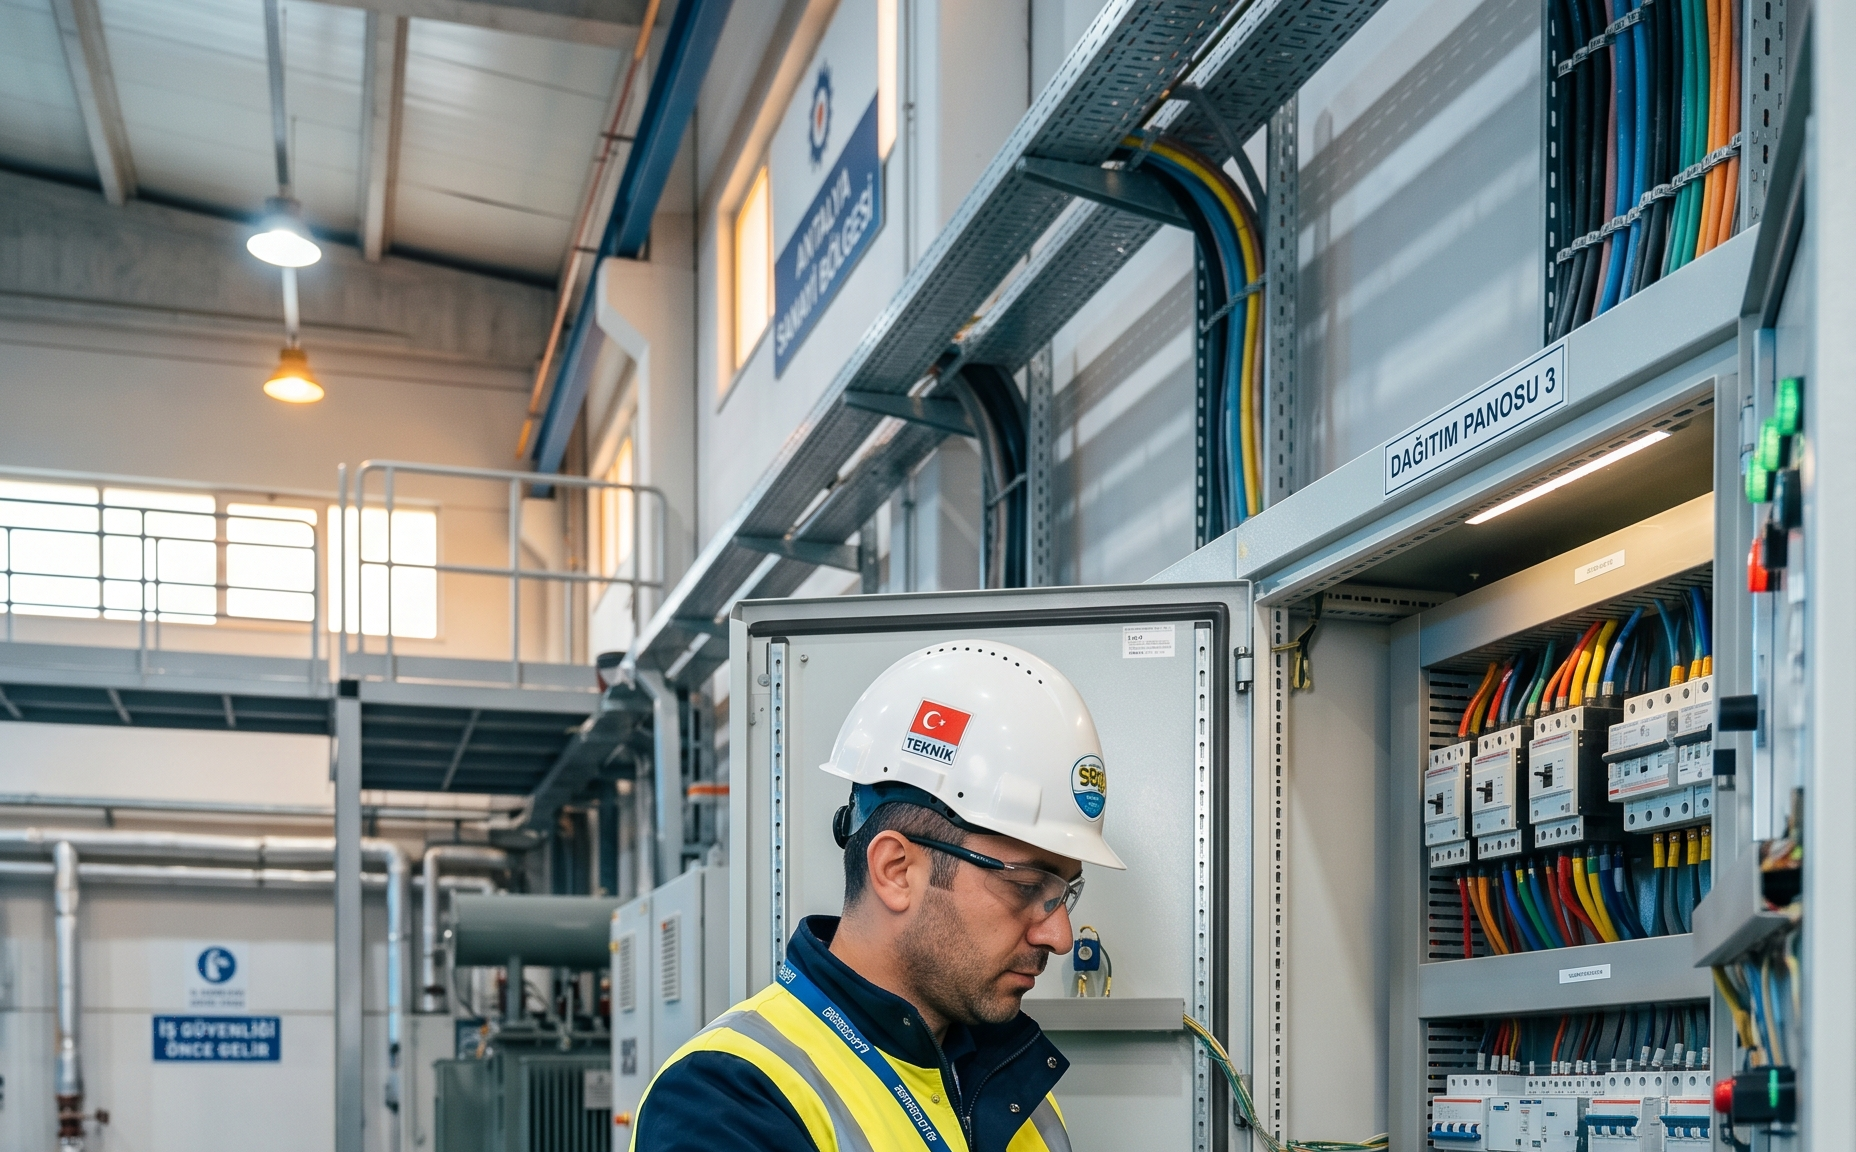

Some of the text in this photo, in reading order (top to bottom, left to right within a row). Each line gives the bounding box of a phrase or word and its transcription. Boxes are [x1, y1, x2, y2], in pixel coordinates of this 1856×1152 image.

[796, 167, 851, 281] ANTALYA
[819, 173, 873, 296] BÖLGESİ
[1391, 367, 1556, 479] DAĞITIM PANOSU 3
[907, 737, 954, 761] TEKNİK
